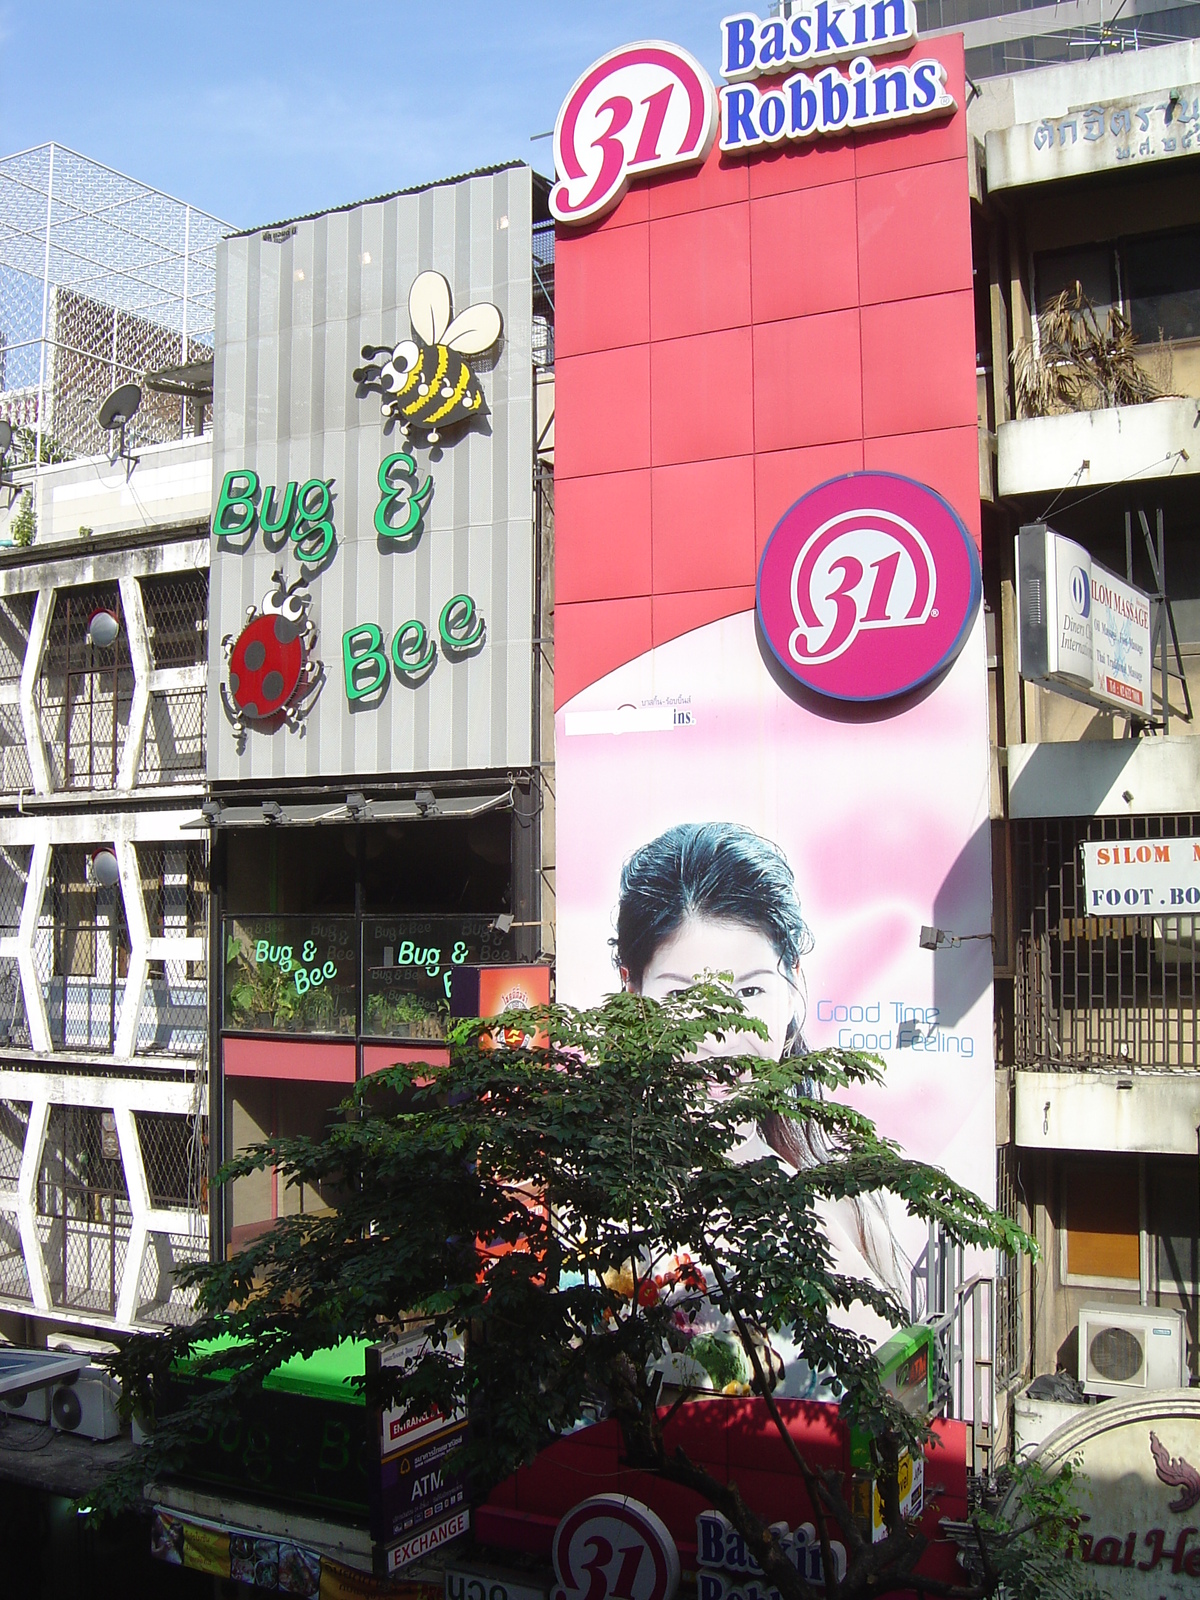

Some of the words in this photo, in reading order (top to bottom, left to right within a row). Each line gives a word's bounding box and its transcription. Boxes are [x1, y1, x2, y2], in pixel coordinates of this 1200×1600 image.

[725, 0, 907, 73] Baskin
[725, 63, 937, 145] Robbins
[555, 83, 675, 214] 31
[212, 468, 336, 562] Bug
[373, 452, 433, 537] &
[795, 551, 901, 658] 31
[1063, 614, 1085, 637] Diners
[1091, 579, 1112, 609] ILOM
[1113, 592, 1149, 630] MASSAGE
[342, 594, 485, 700] Bee
[1097, 844, 1171, 866] SILOM
[255, 940, 293, 972] Bug
[302, 940, 317, 962] &
[294, 960, 338, 995] Bee
[398, 941, 441, 977] Bug
[451, 941, 469, 964] &
[817, 1000, 881, 1023] Good
[889, 1002, 940, 1025] Time
[838, 1028, 892, 1051] Good
[900, 1030, 974, 1058] Feeling
[411, 1469, 444, 1501] ATM
[393, 1514, 465, 1566] EXCHANGE
